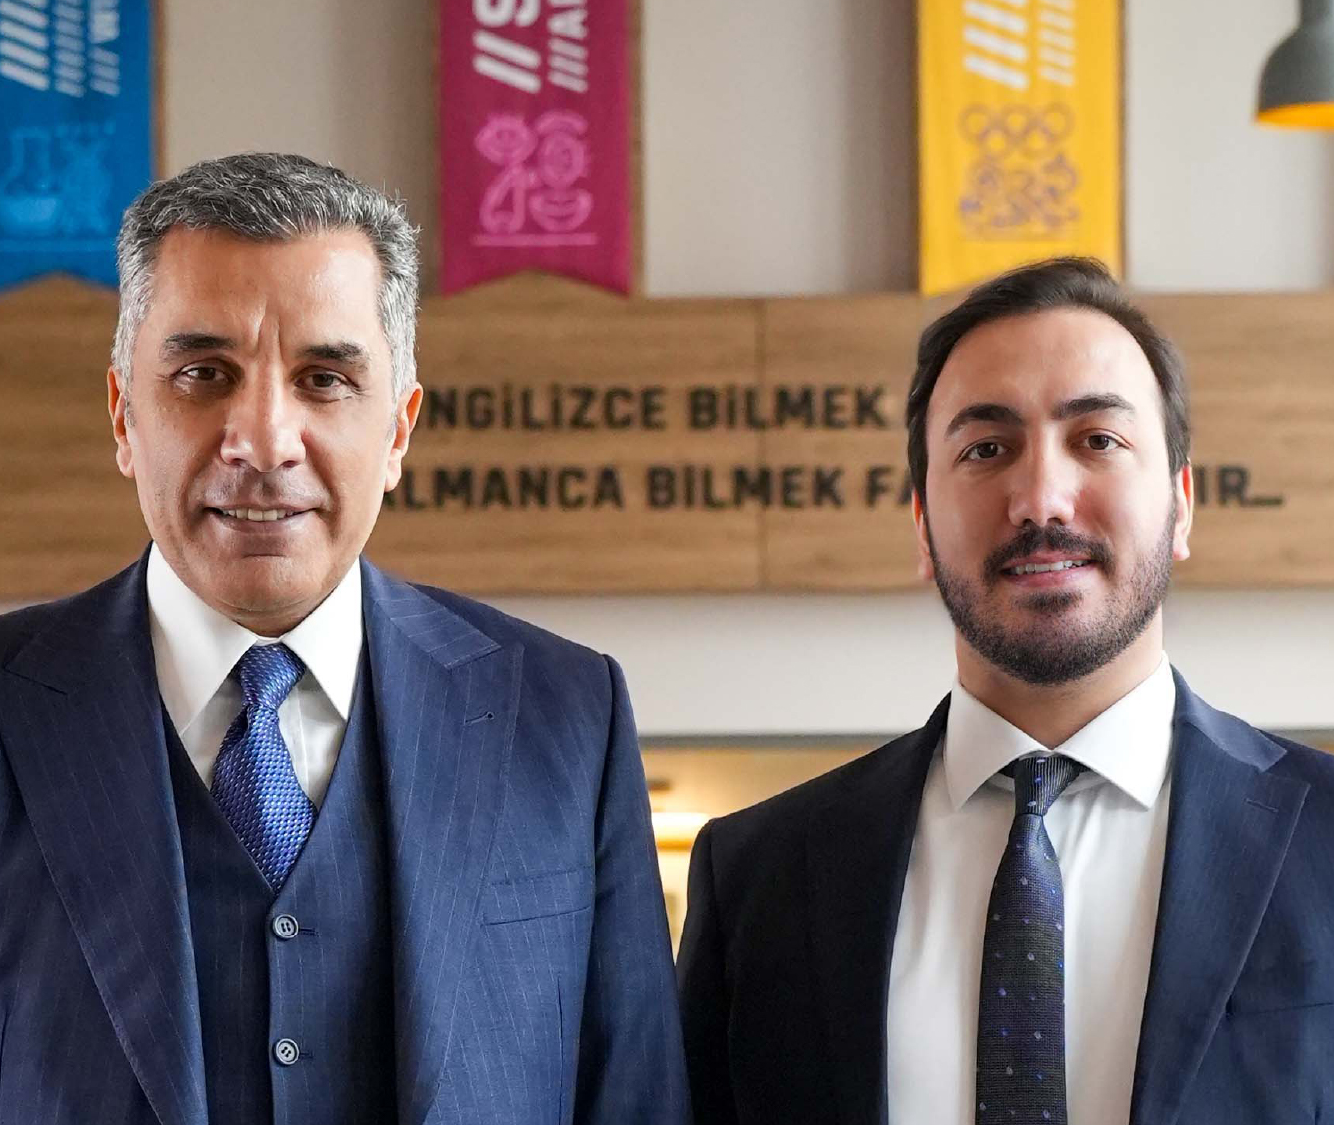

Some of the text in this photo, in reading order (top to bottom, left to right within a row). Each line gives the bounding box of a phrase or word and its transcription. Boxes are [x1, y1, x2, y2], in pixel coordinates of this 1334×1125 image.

[426, 382, 886, 430] NGİLİZCE BİLMEK
[646, 462, 843, 509] BİLMEK
